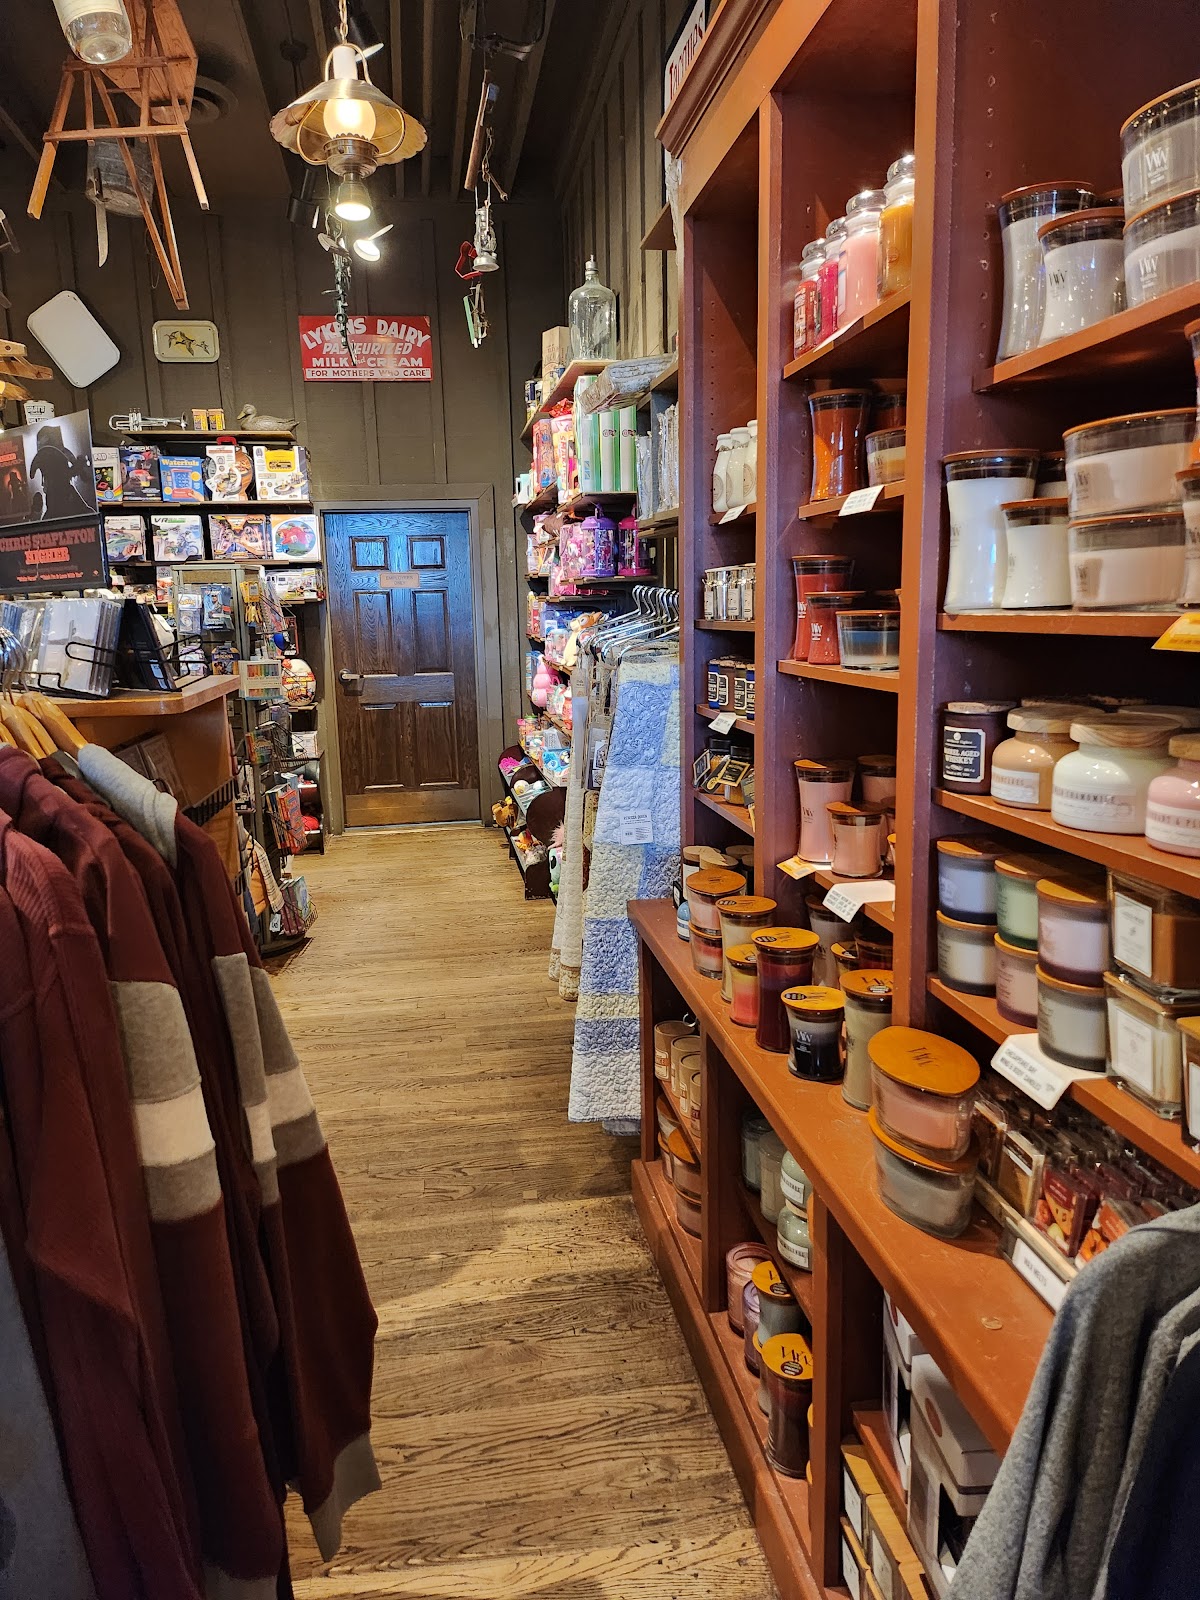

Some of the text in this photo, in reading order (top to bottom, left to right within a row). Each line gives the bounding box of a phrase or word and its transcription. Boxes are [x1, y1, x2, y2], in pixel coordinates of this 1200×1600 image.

[377, 318, 430, 348] DAIRY
[312, 357, 350, 368] MILK
[367, 357, 423, 368] CREAM
[333, 369, 375, 378] MOTHERS
[379, 369, 399, 377] WHO
[0, 527, 96, 552] CHRIS STAPLETON
